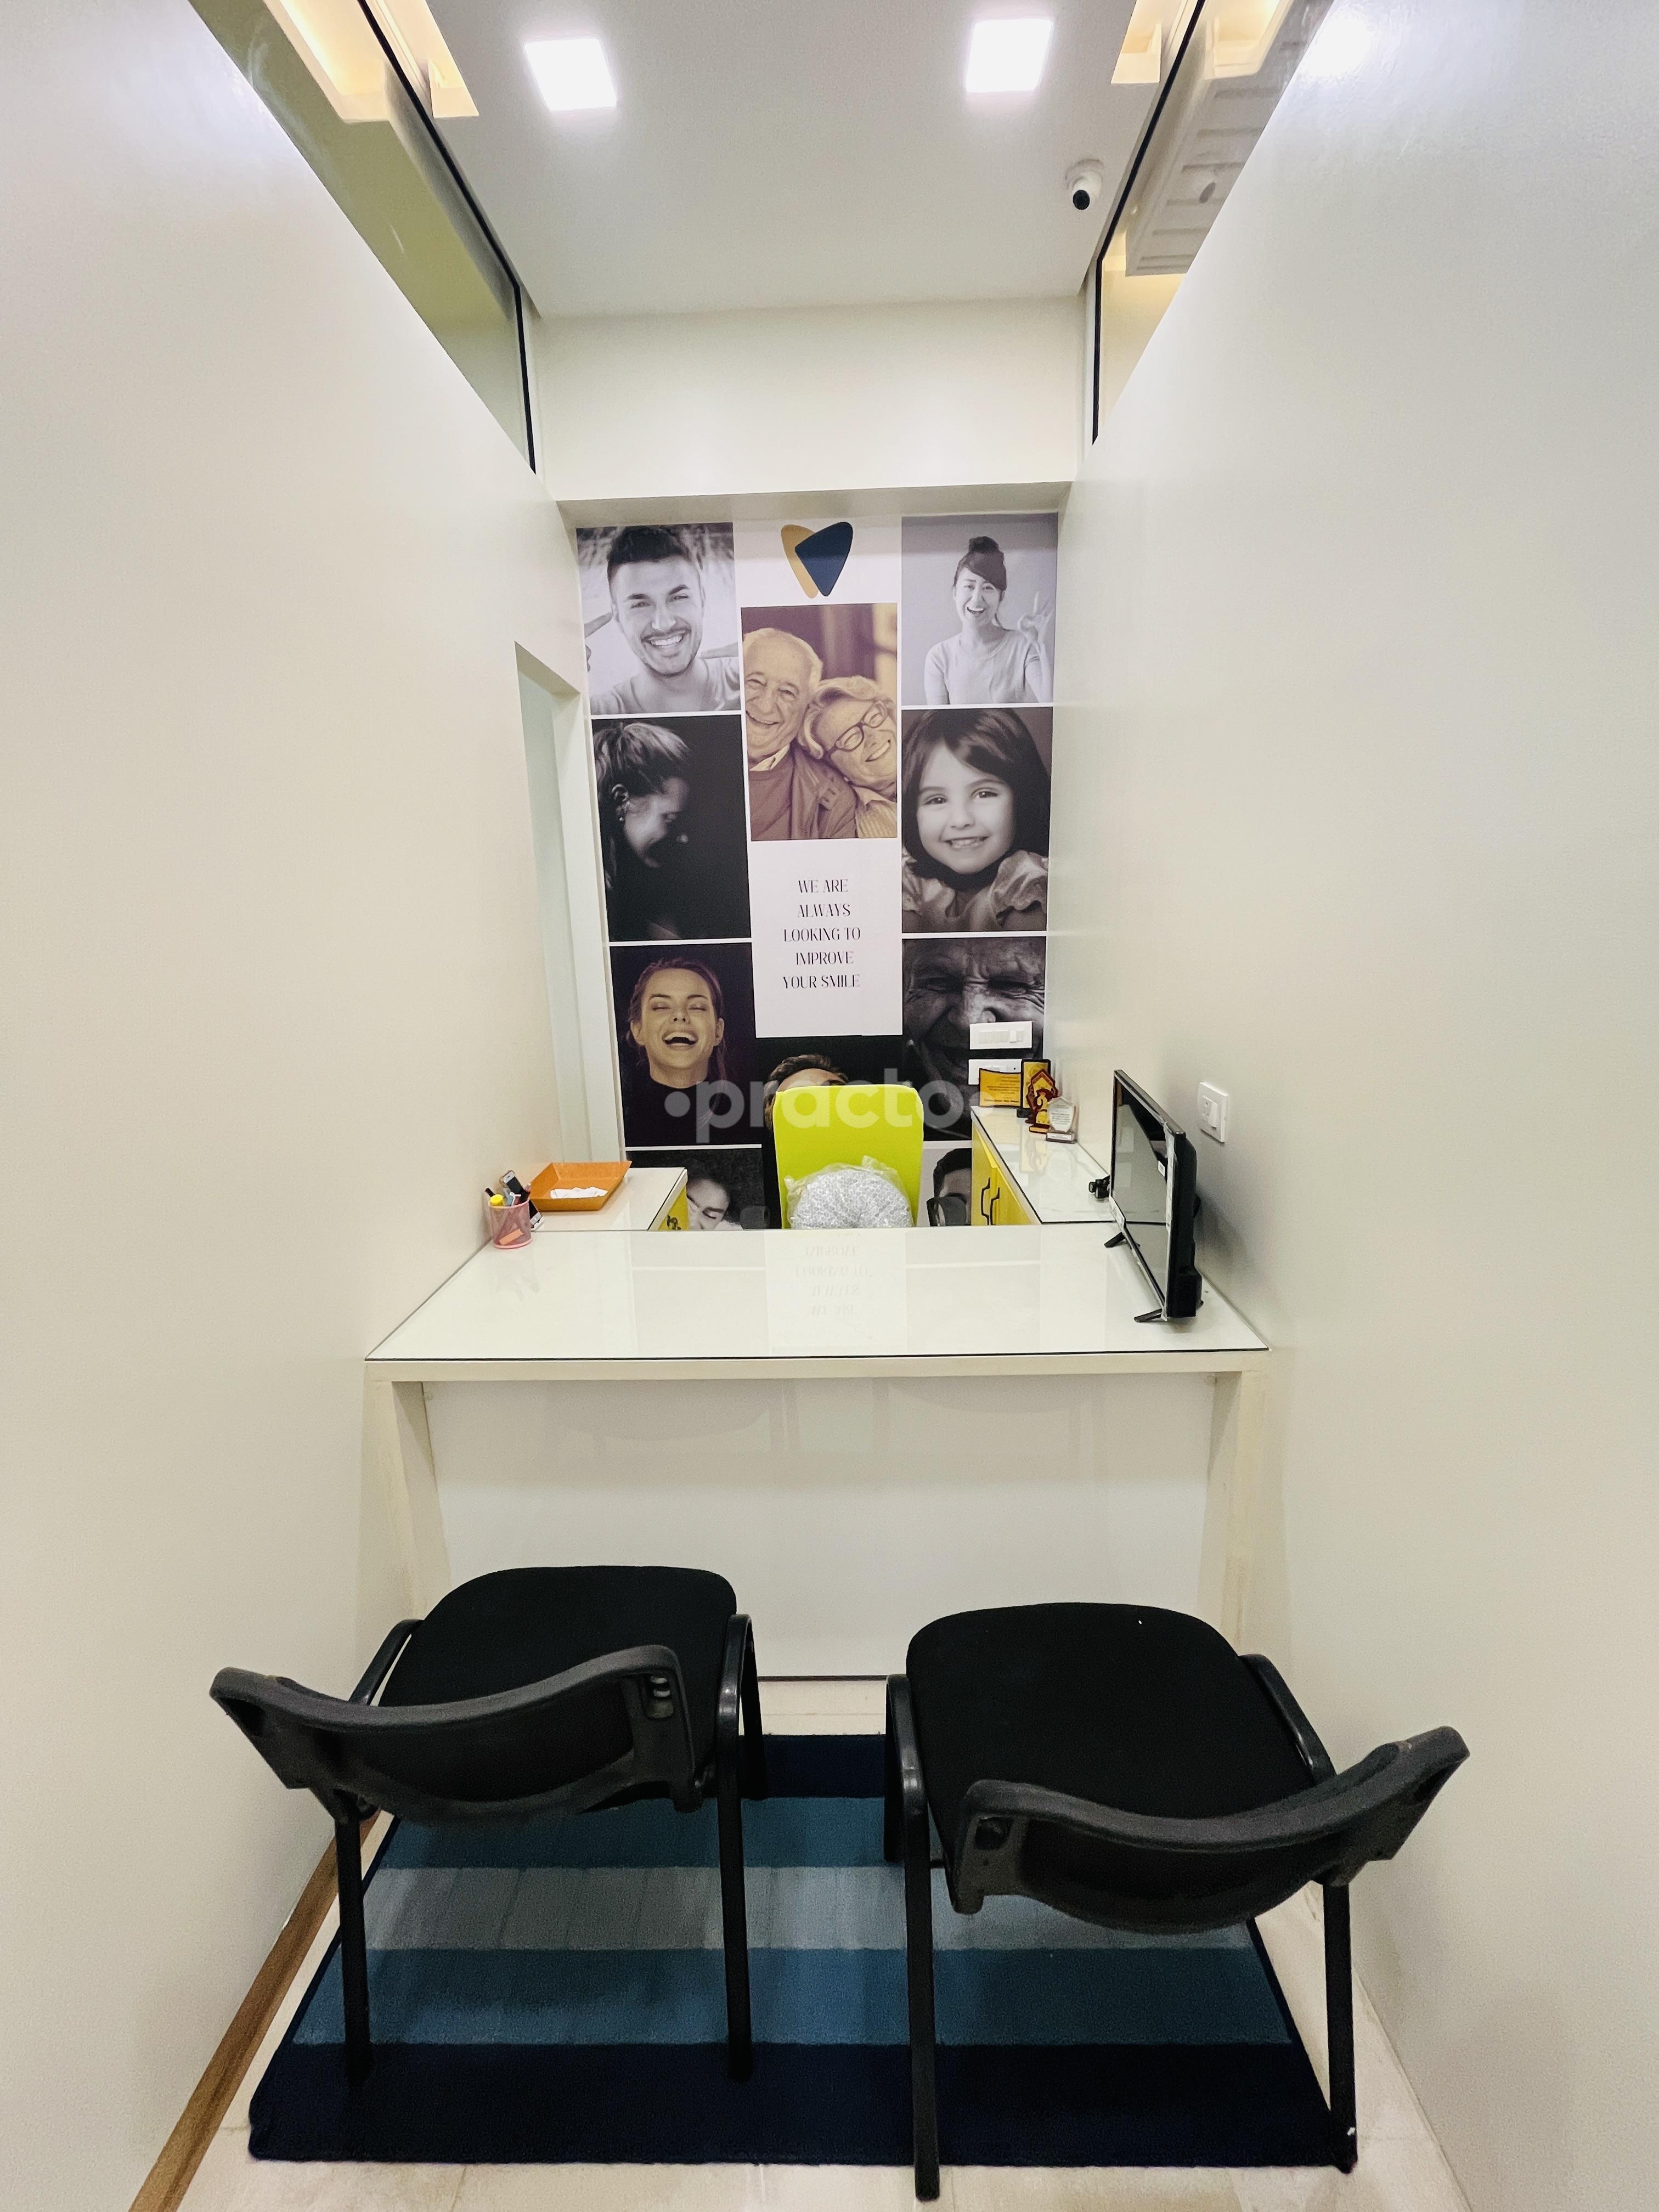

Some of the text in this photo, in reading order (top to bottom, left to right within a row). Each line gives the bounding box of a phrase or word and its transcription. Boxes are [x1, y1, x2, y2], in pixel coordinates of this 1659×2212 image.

[798, 879, 848, 893] WE ARE
[797, 903, 851, 917] ALWAYS
[783, 927, 861, 942] LOOKING TO
[795, 951, 854, 966] IMPROVE
[783, 974, 860, 989] YOUR SMILE
